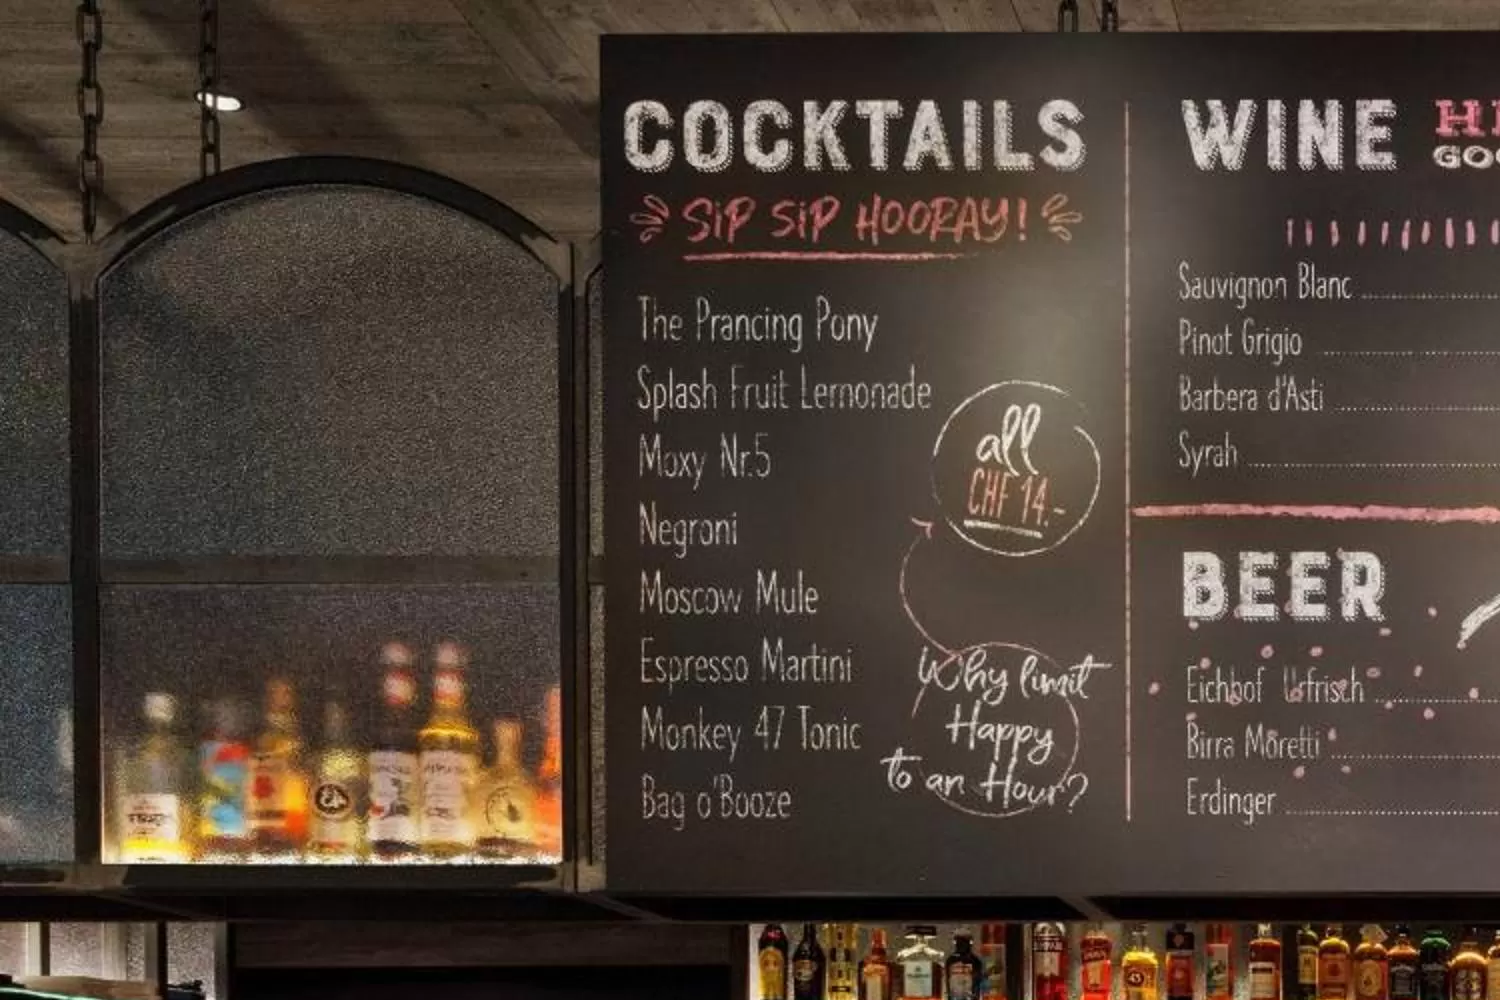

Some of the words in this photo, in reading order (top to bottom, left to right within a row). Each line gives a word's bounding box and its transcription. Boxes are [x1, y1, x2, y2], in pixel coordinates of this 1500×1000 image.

[623, 99, 1086, 173] COCKTAILS
[1181, 98, 1397, 171] WINE
[855, 193, 1028, 245] HOORAY!
[1178, 260, 1287, 310] Sauvignon
[1298, 261, 1353, 300] Blanc
[638, 295, 683, 341] The
[696, 296, 803, 353] Prancing
[816, 295, 879, 353] Pony
[1179, 317, 1233, 356] Pinot
[1241, 317, 1303, 366] Grigio
[637, 364, 717, 422] Splash
[730, 364, 789, 410] Fruit
[801, 364, 932, 410] Lemonade
[1179, 375, 1258, 412] Barbera
[1267, 374, 1324, 412] d'Asti
[639, 433, 705, 491] Moxy
[975, 403, 1042, 476] all
[1178, 430, 1238, 477] Syrah
[967, 467, 1013, 519] CHF
[639, 501, 738, 559] Negroni
[639, 569, 742, 615] Moscow
[756, 569, 819, 615] Mule
[1182, 550, 1386, 622] BEER
[640, 636, 749, 691] Espresso
[761, 636, 852, 683] Martini
[918, 646, 1008, 703] Why
[641, 705, 741, 762] Monkey
[754, 705, 785, 750] 47
[797, 704, 861, 751] Tonic
[946, 699, 1054, 765] Happy
[641, 773, 685, 832] Bag
[880, 747, 921, 790] to
[926, 771, 965, 796] an
[980, 758, 1089, 813] Hour?
[1187, 777, 1277, 829] Erdinger
